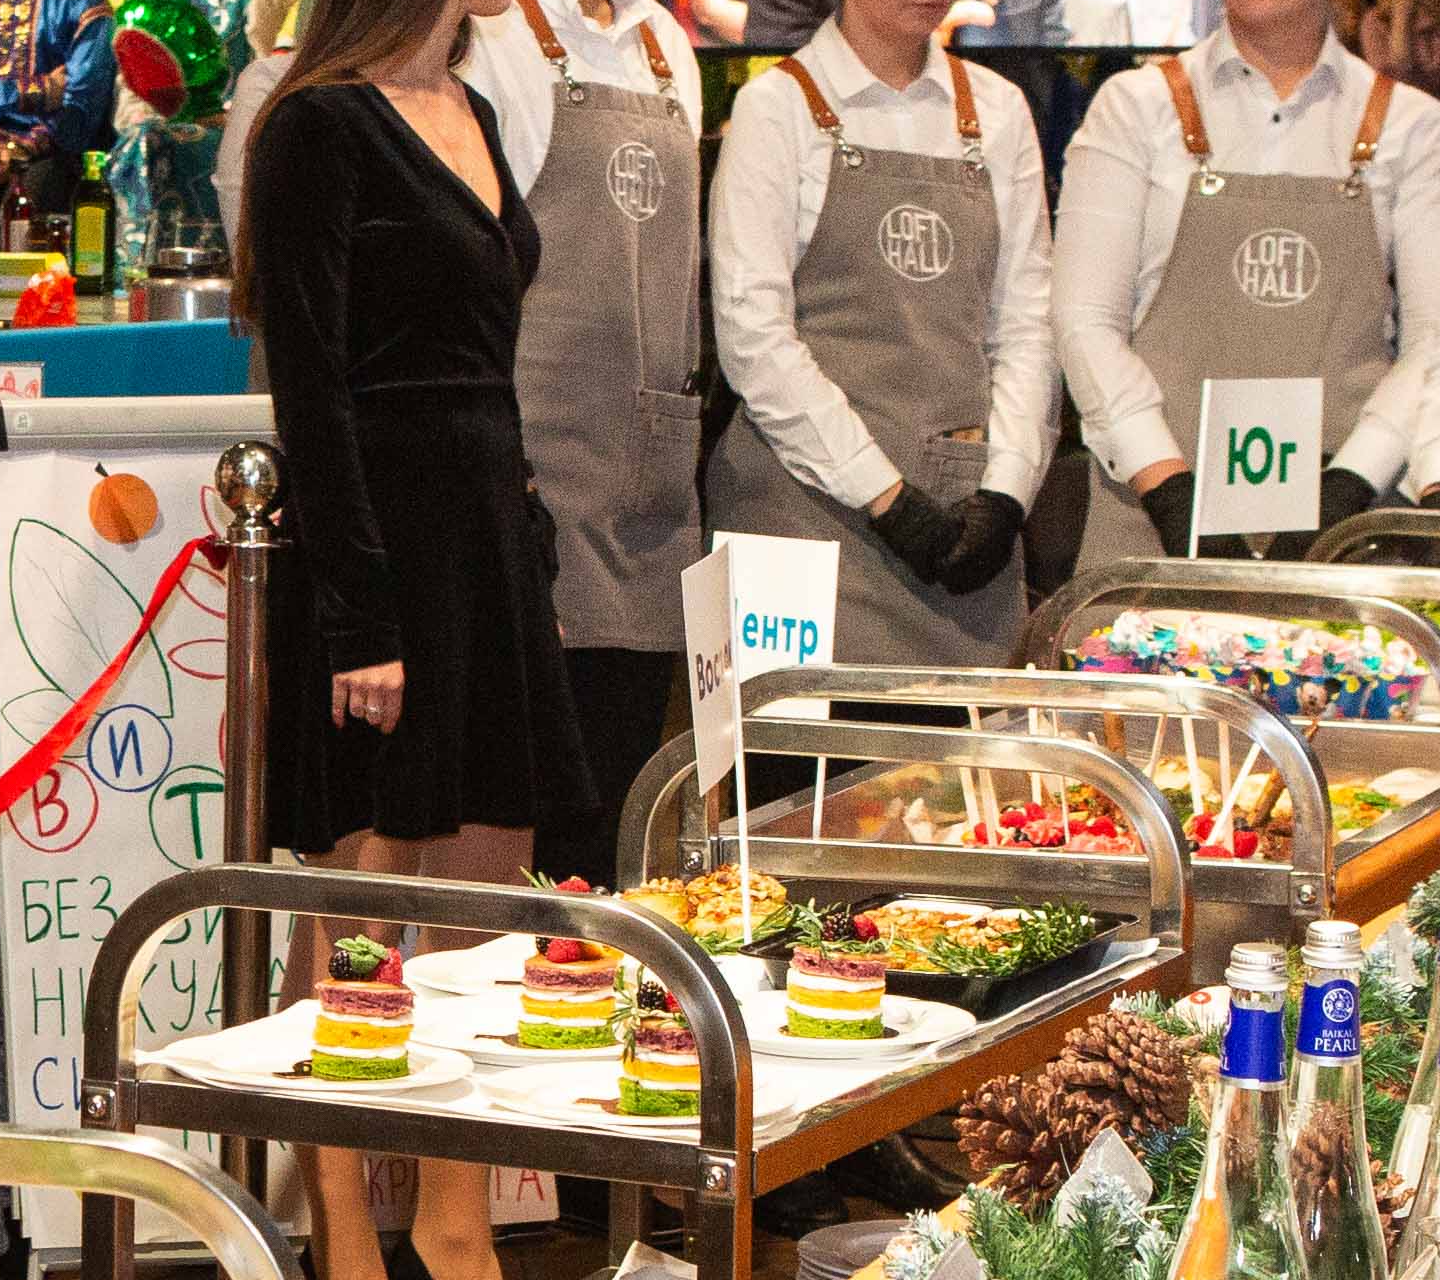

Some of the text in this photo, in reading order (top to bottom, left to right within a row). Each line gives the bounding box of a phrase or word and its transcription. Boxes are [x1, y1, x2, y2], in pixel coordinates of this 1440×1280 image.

[887, 211, 938, 241] LOFT
[887, 239, 944, 273] HALL
[1244, 235, 1305, 267] LOFT
[1242, 264, 1305, 298] HALL
[1227, 426, 1297, 485] Юг
[735, 597, 818, 664] ентр
[1314, 1038, 1358, 1052] PEARL
[1322, 1029, 1354, 1038] BAIKAL
